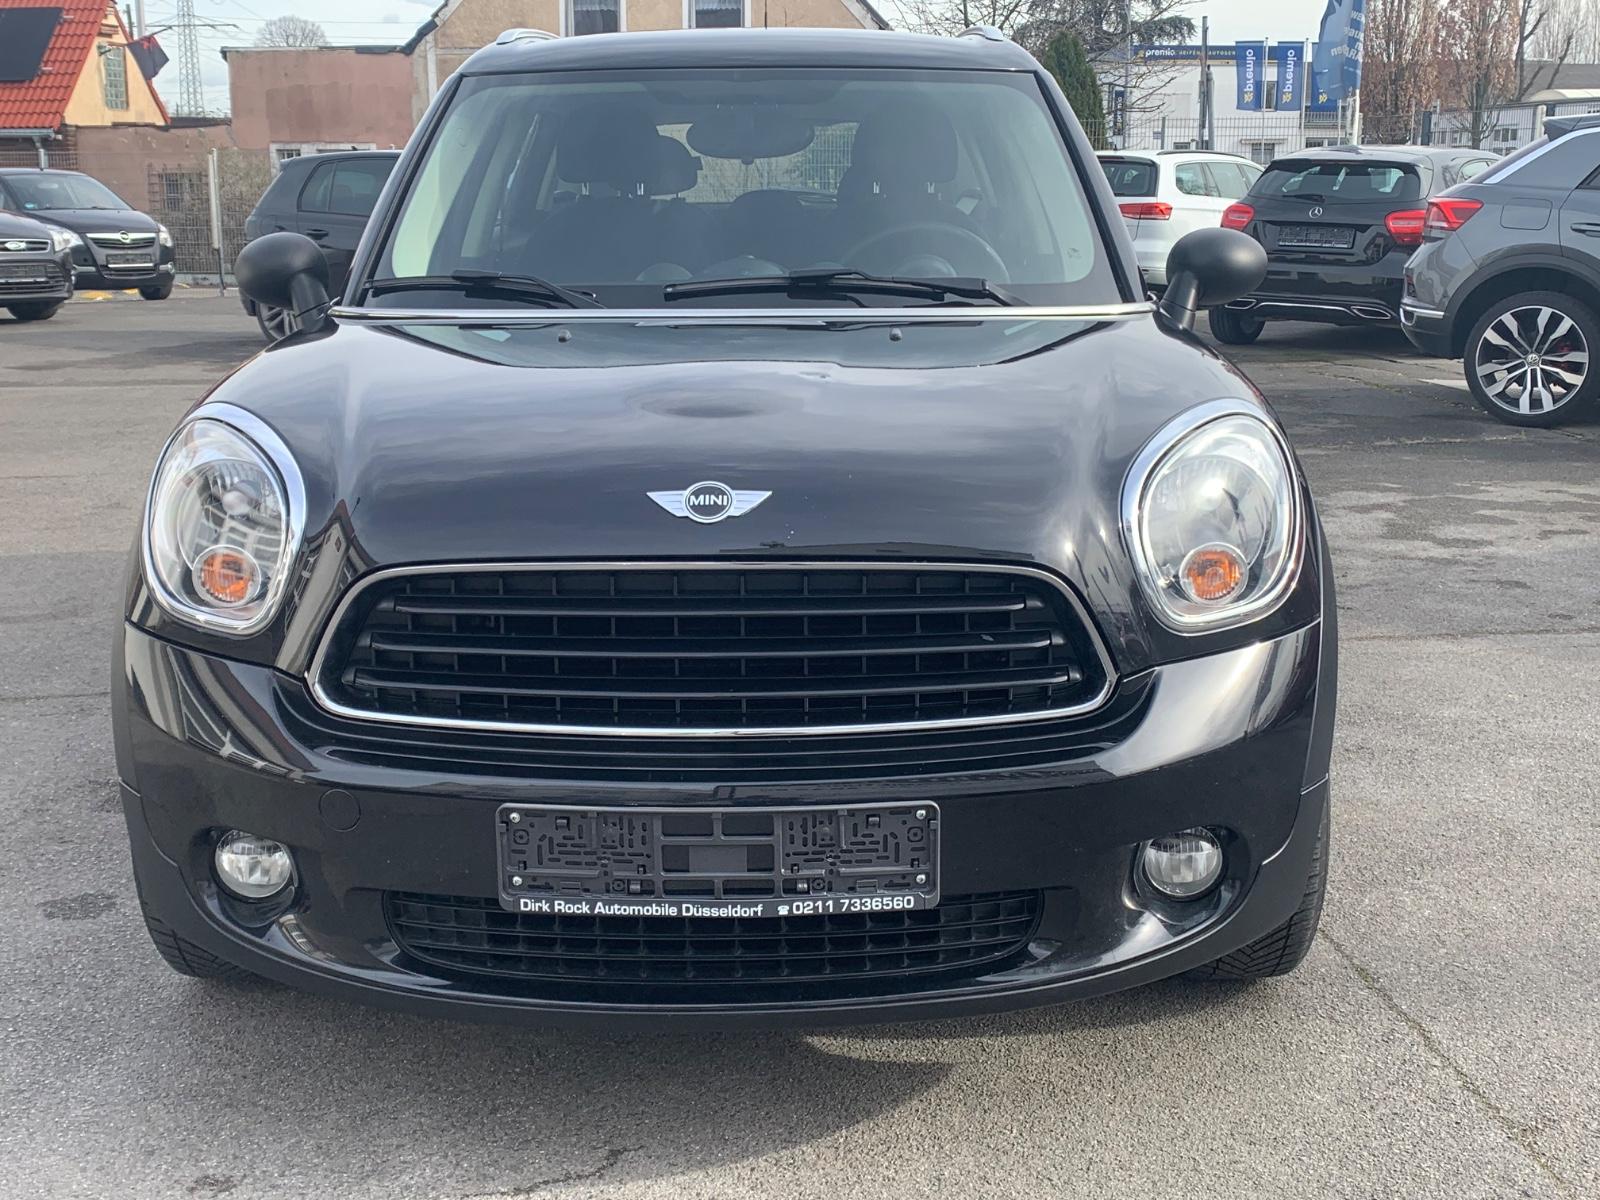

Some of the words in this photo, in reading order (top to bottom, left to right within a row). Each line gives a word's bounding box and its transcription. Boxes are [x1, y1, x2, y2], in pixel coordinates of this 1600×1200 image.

[1145, 47, 1176, 58] premio
[689, 494, 728, 506] MINI
[520, 898, 551, 913] Dirk
[554, 900, 591, 914] Rock
[594, 901, 678, 916] Automobile
[682, 903, 763, 917] Düsseldorf
[792, 900, 834, 914] 0211
[840, 896, 914, 912] 7336560
